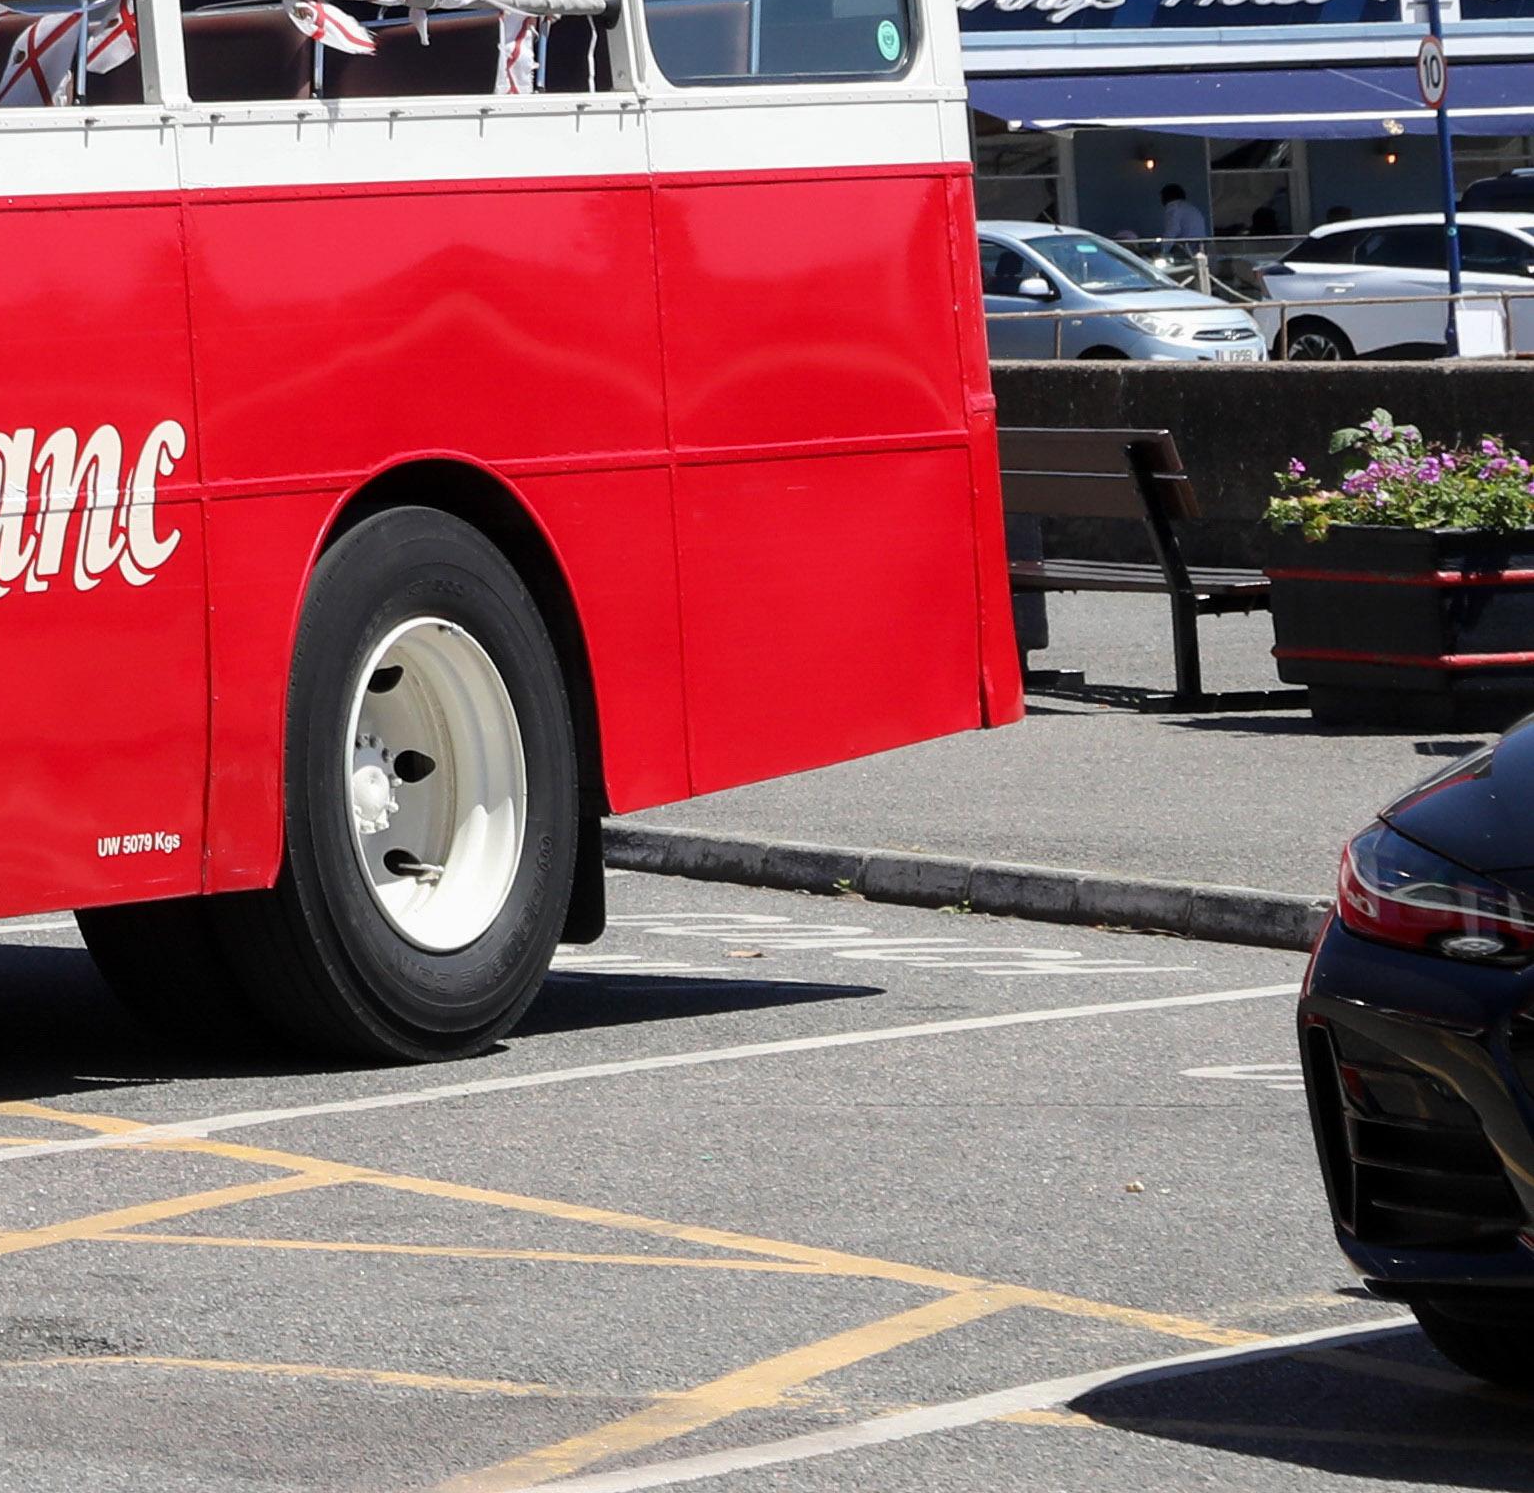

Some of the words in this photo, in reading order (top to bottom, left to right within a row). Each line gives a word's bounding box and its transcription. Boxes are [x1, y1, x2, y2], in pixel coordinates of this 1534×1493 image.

[1423, 55, 1441, 88] 10
[98, 837, 120, 857] UW
[123, 833, 152, 855] 5079
[154, 831, 180, 853] Kgs
